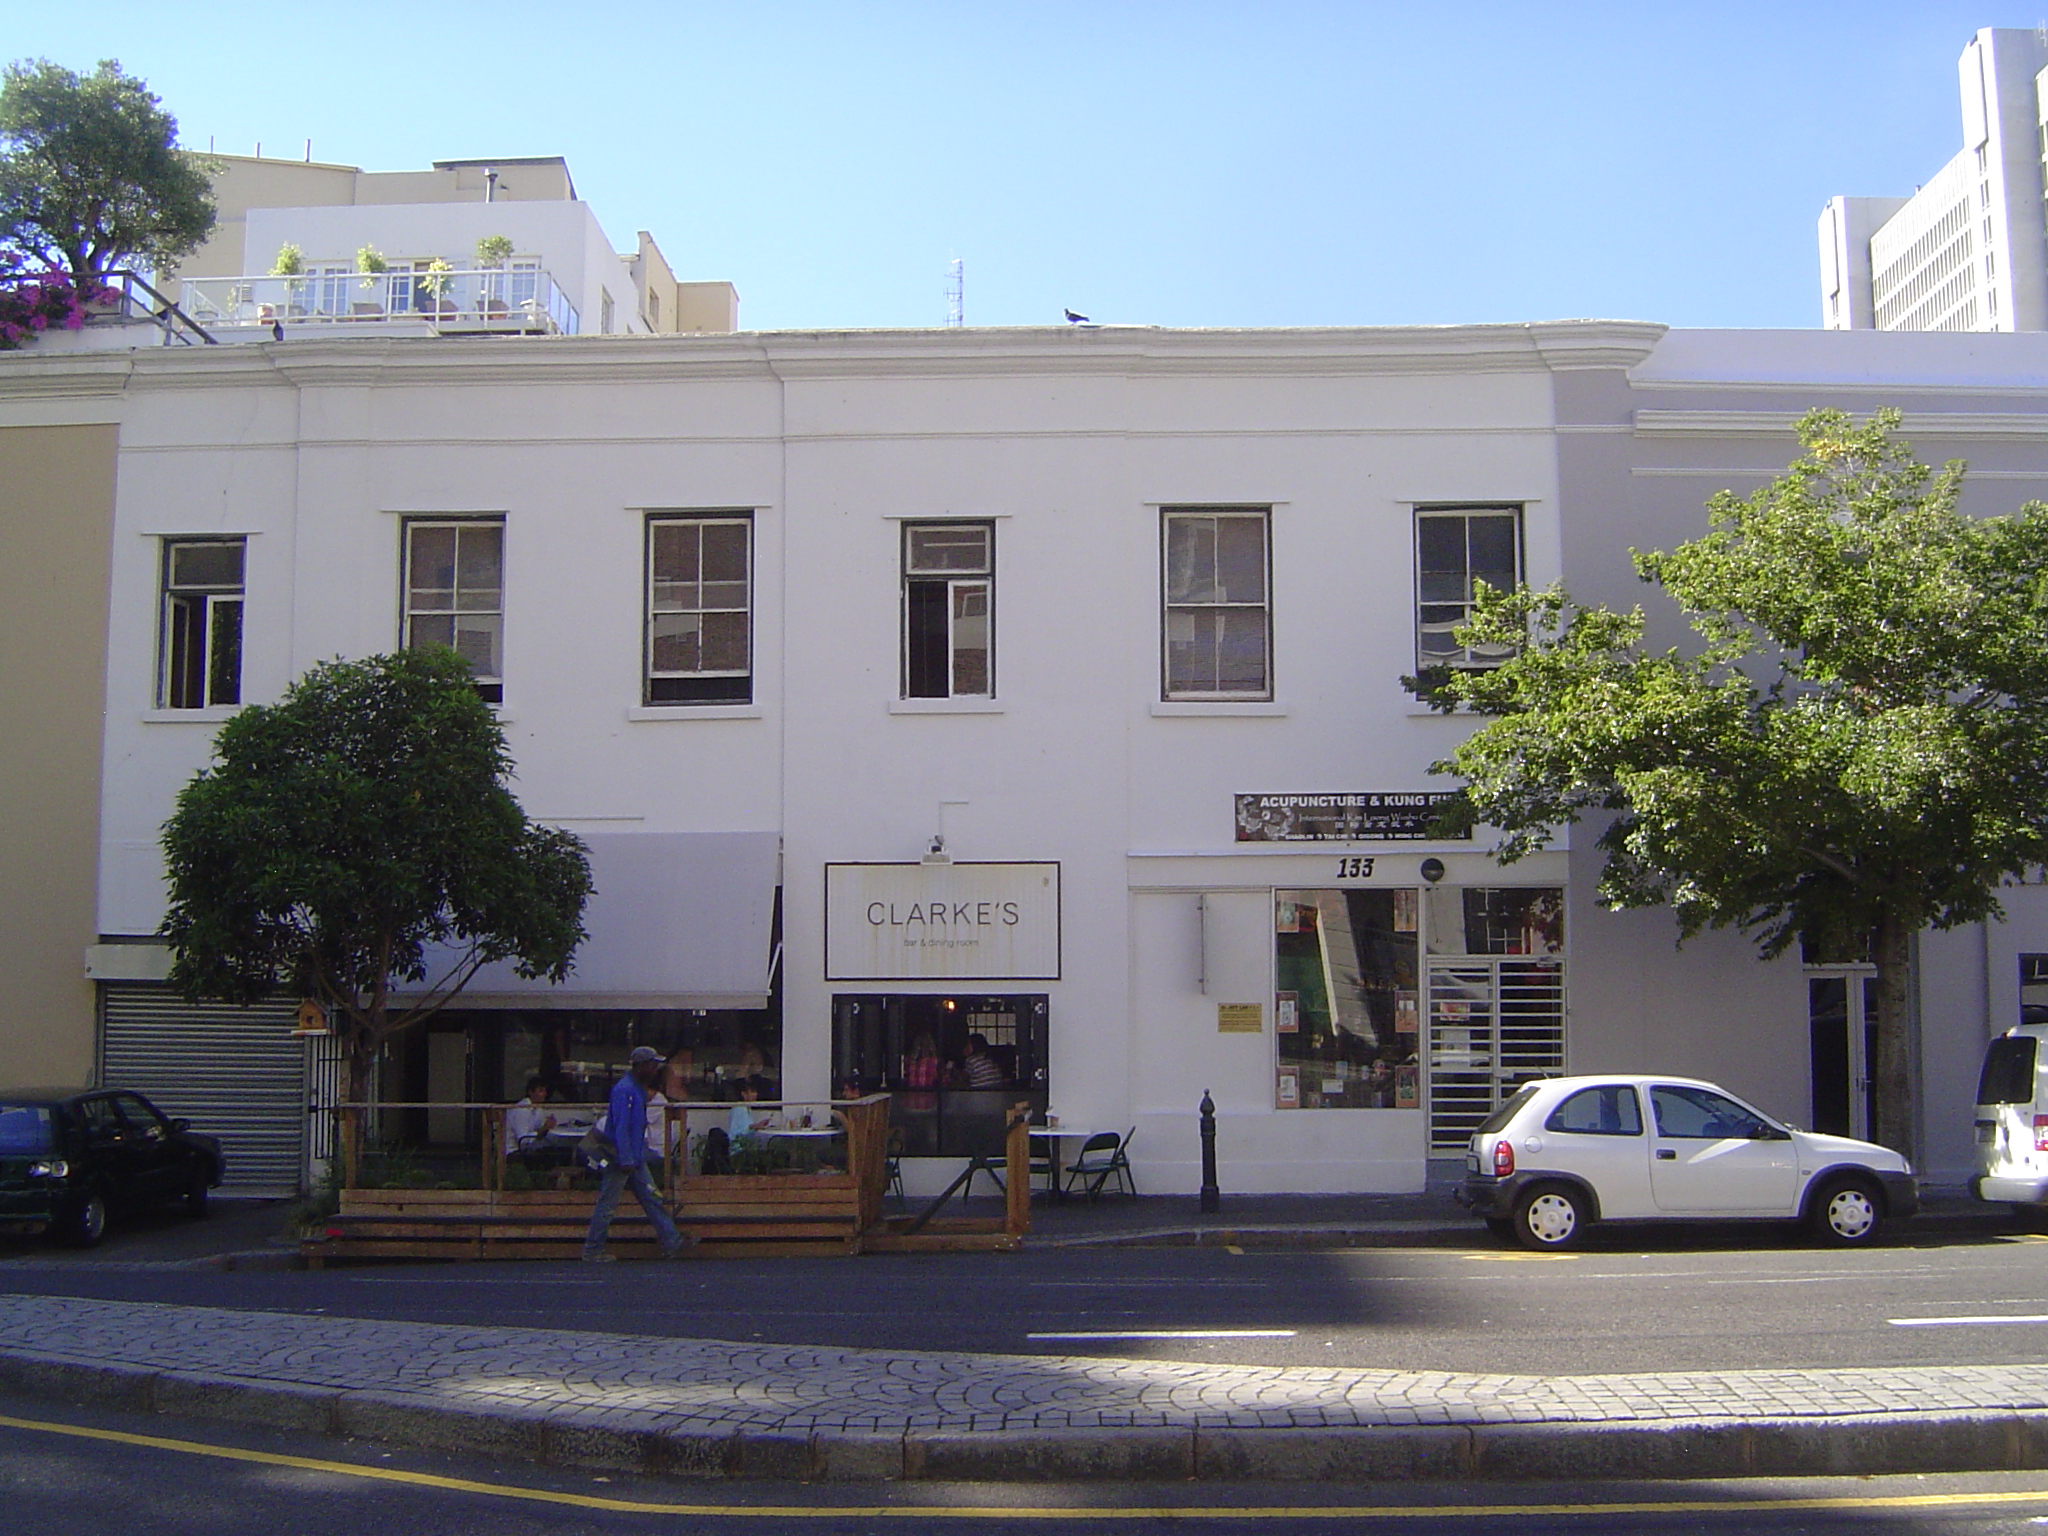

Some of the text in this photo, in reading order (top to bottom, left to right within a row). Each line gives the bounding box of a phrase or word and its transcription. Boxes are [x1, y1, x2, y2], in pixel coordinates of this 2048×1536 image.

[1259, 795, 1366, 808] ACUPUNCTURE
[1370, 795, 1380, 807] &
[1384, 795, 1425, 807] KUNG
[1337, 858, 1375, 878] 133
[867, 902, 1019, 926] CLARKE'S
[903, 938, 979, 949] bar & dining room
